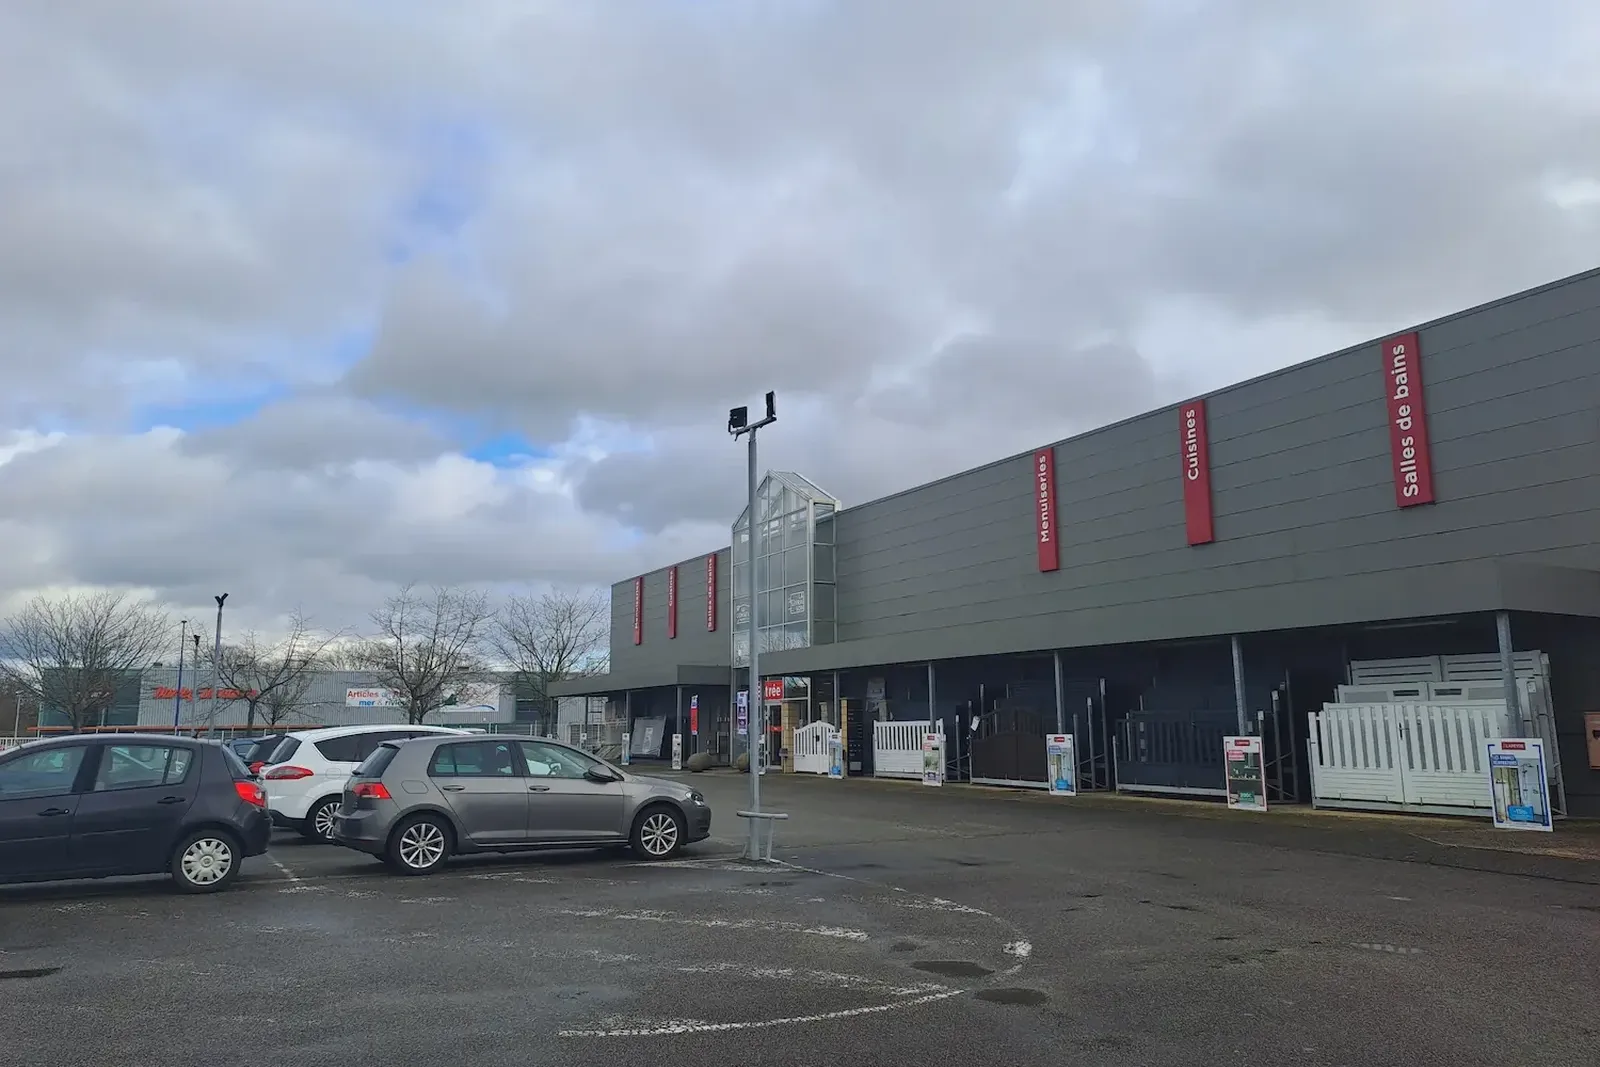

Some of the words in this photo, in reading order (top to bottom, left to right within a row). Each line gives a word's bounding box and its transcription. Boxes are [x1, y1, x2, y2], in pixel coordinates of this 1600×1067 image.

[1391, 344, 1410, 400] bains
[1186, 409, 1199, 481] Cuisines
[1396, 404, 1413, 431] de
[1400, 436, 1419, 498] Salles
[1038, 455, 1050, 543] Menuiseries
[347, 690, 379, 698] Articles
[764, 683, 781, 698] trée
